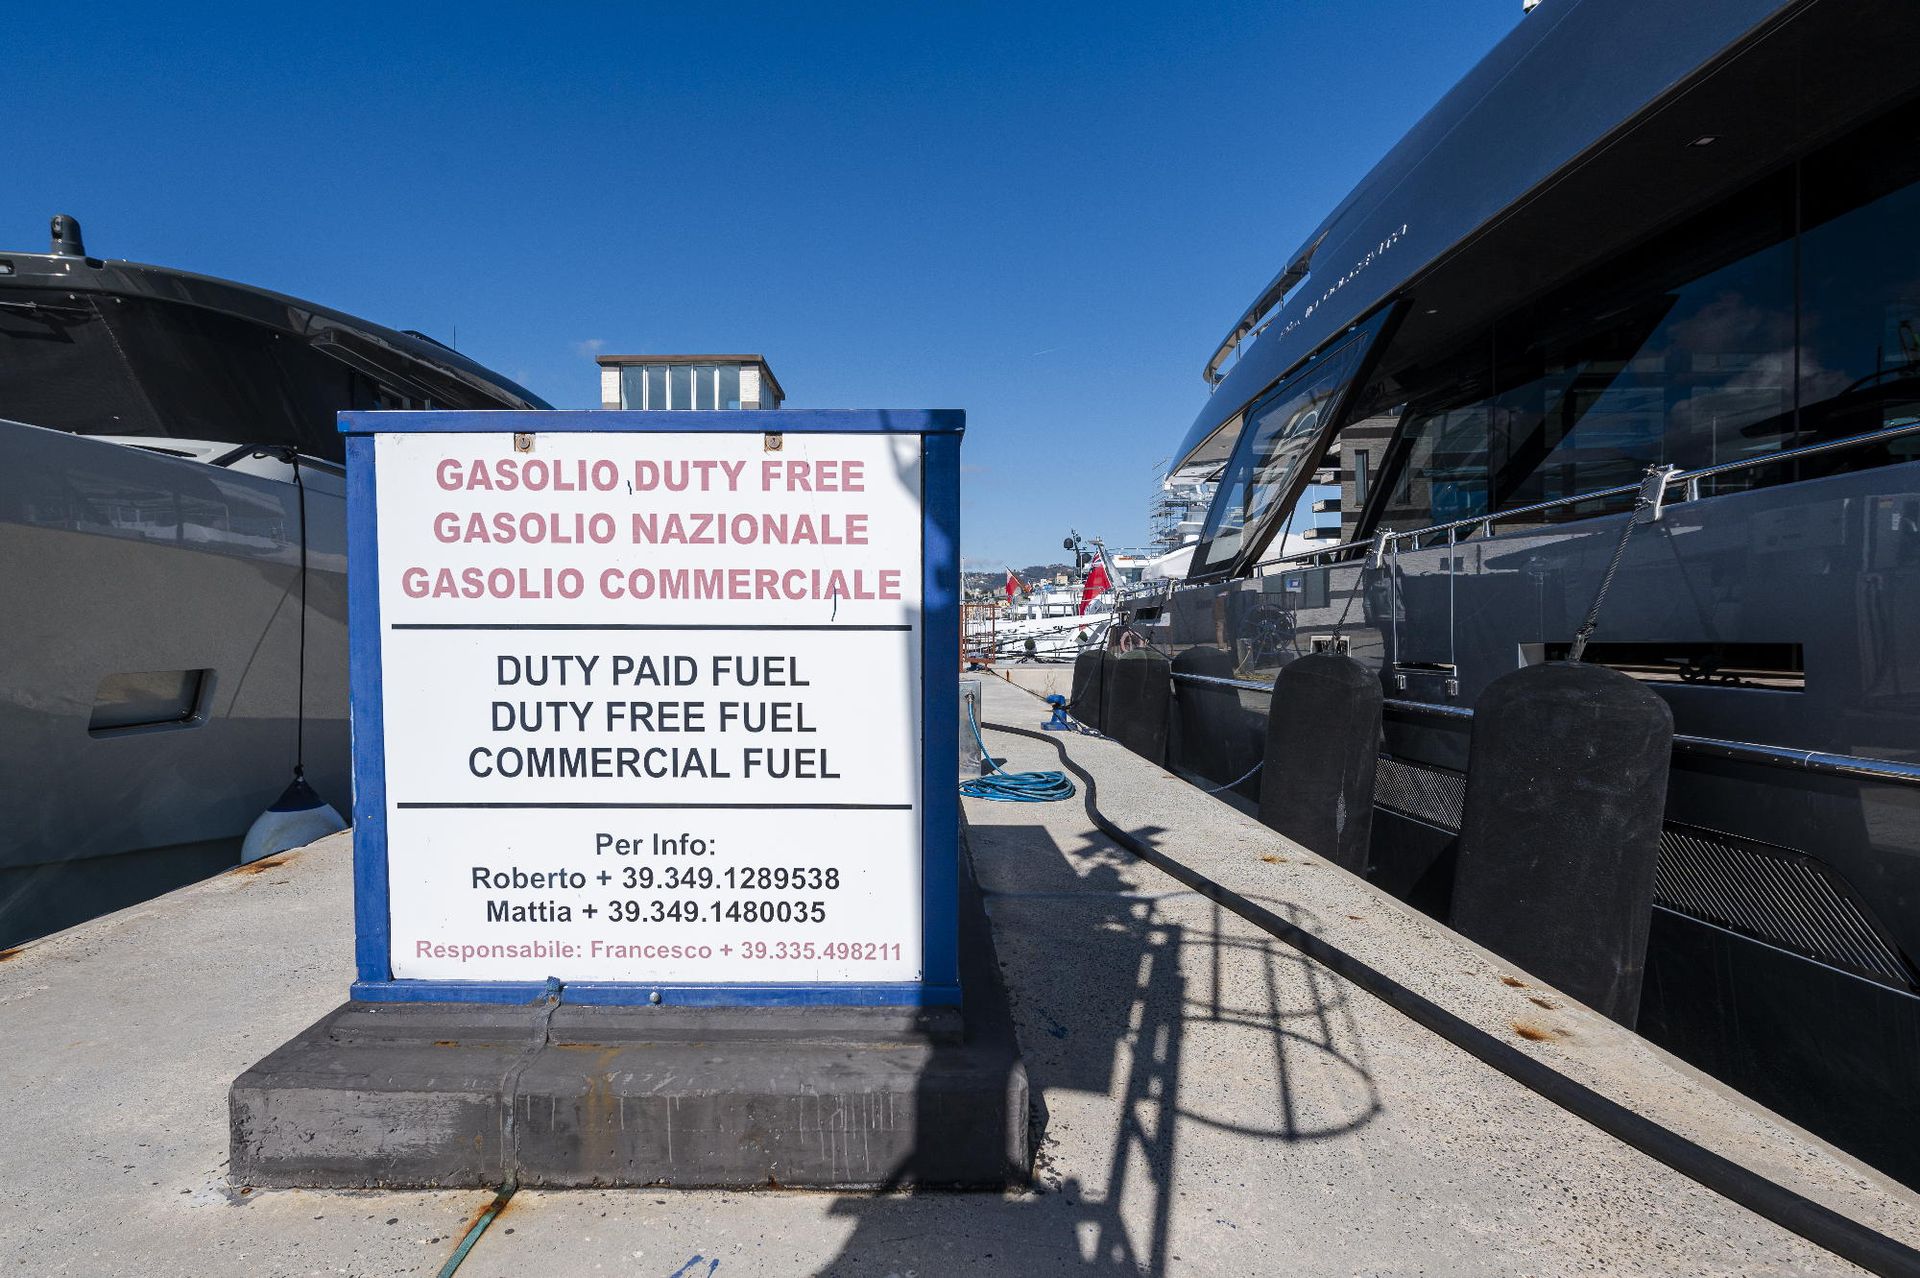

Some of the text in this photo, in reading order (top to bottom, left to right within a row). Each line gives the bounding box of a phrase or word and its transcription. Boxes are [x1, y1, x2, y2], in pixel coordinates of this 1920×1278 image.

[437, 459, 864, 491] GASOLIO DUTY FREE
[434, 513, 868, 544] GASOLIO NAZIONALE
[402, 568, 900, 599] GASOLIO COMMERCIALE
[497, 656, 809, 686] DUTY PAID FUEL
[492, 702, 816, 732] DUTY FREE FUEL
[469, 747, 840, 778] COMMERCIAL FUEL
[596, 833, 714, 856] Per Info:
[472, 867, 839, 889] Roberto + 39.349.1289538
[487, 900, 825, 923] Mattia + 39.349.1480035
[417, 941, 900, 962] Responsabile: Francesco + 39.335.498211
